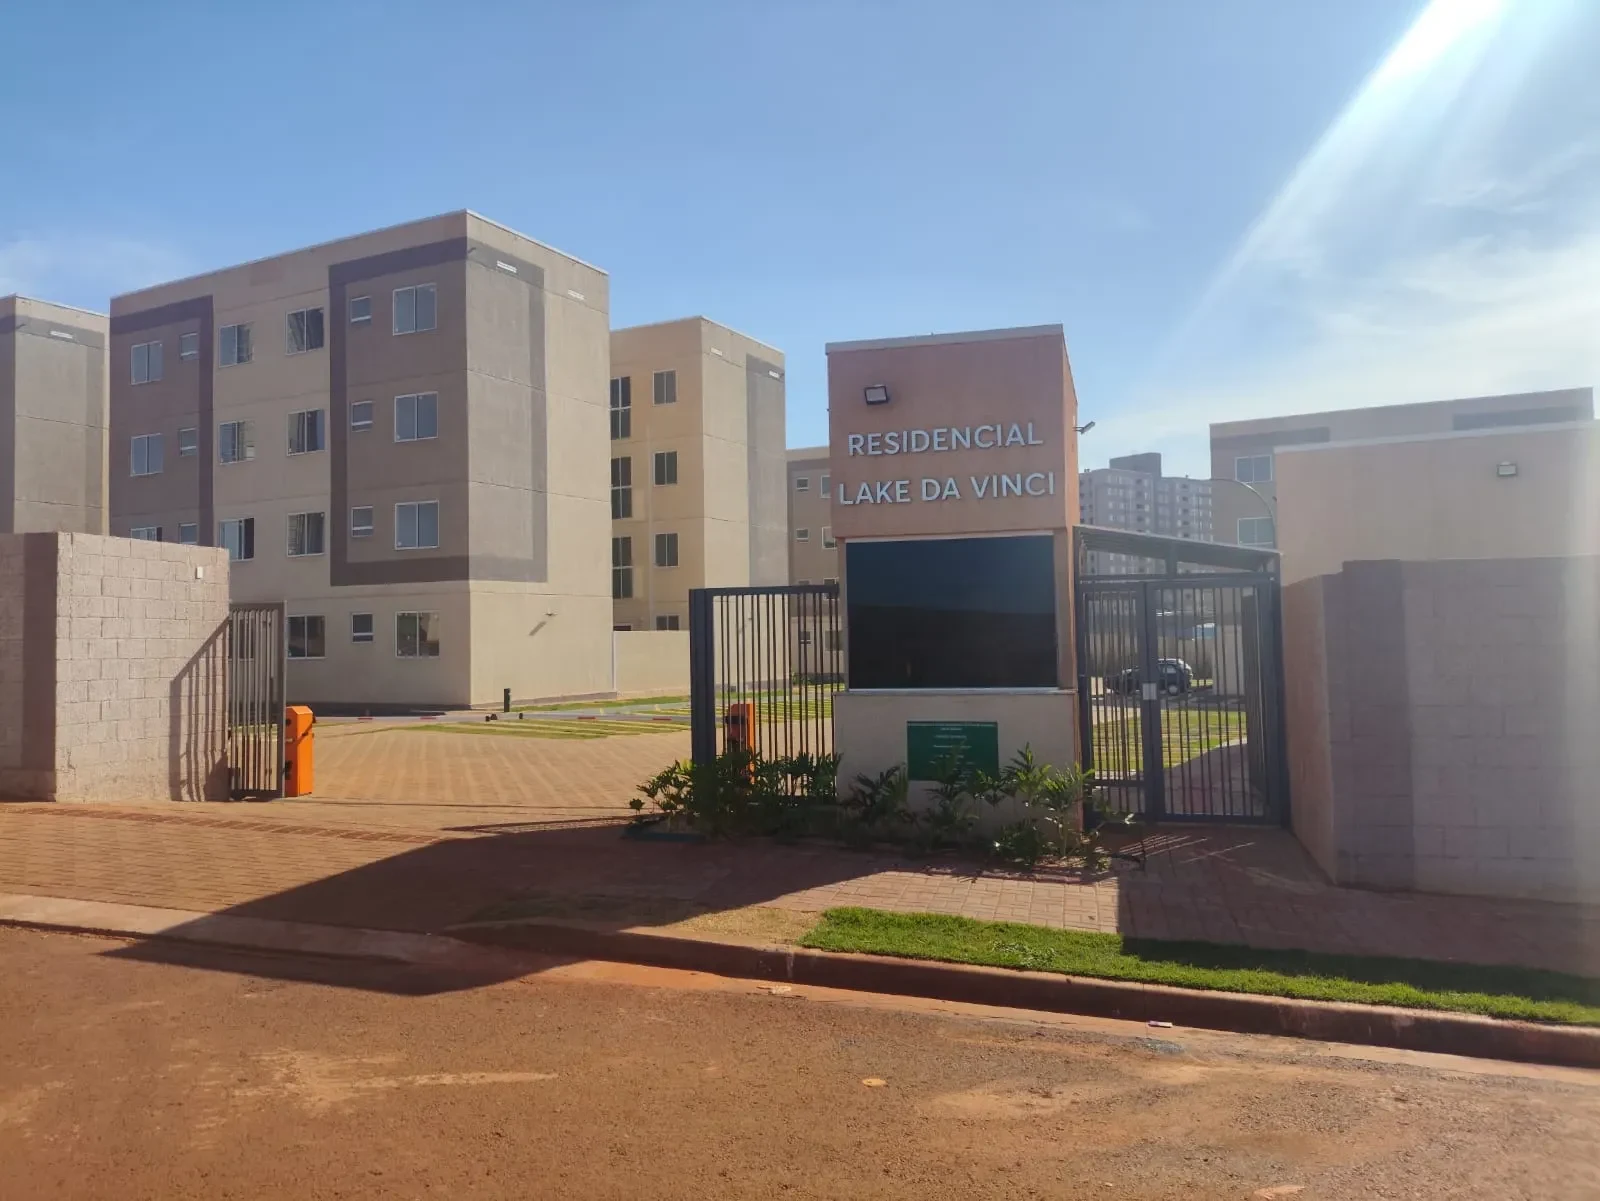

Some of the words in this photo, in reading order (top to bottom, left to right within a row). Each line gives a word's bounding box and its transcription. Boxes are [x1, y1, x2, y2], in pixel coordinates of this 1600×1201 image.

[848, 422, 1043, 456] RESIDENCIAL
[839, 480, 911, 505] LAKE
[922, 477, 961, 501] DA
[970, 471, 1054, 498] VINCI
